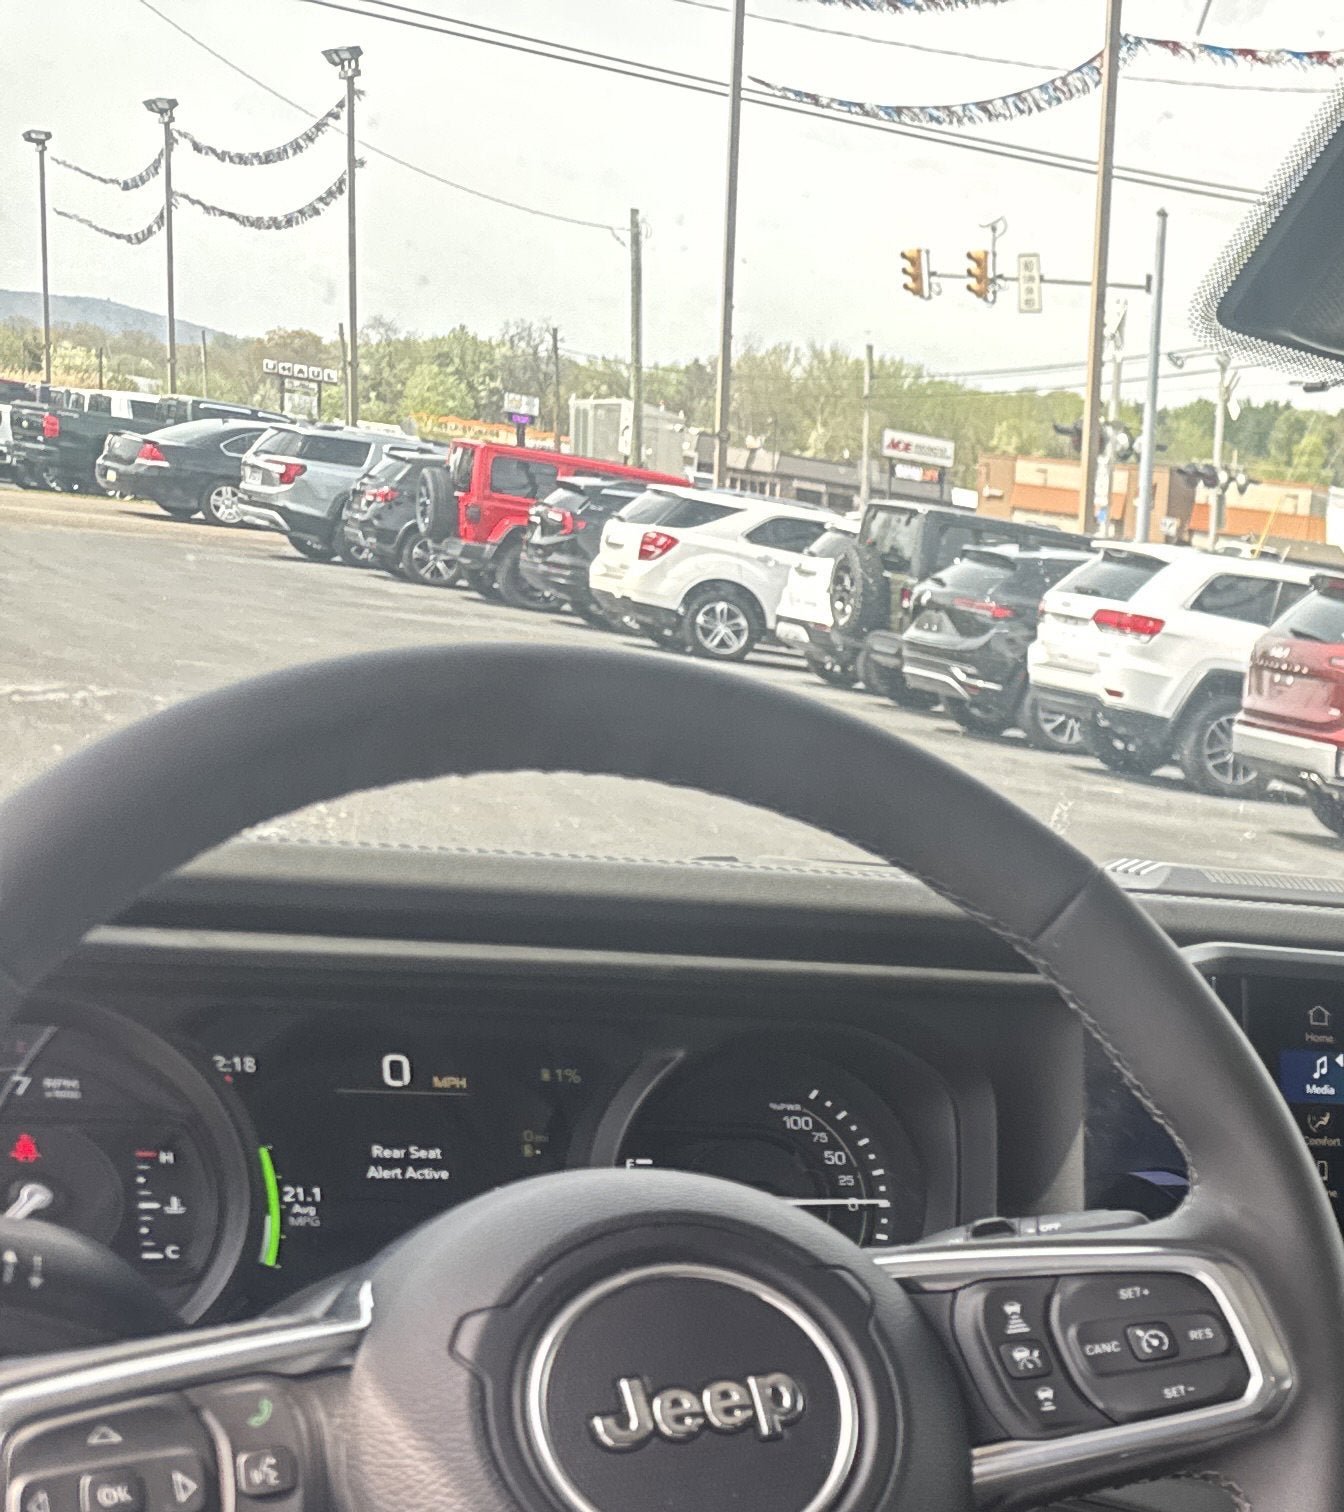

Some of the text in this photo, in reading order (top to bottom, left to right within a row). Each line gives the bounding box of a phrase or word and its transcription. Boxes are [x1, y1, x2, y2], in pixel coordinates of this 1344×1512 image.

[1305, 1033, 1335, 1043] Home
[382, 1053, 411, 1087] 0
[555, 1067, 582, 1084] 1%
[432, 1075, 467, 1089] MPH
[1305, 1083, 1336, 1095] Media
[783, 1115, 813, 1131] 100
[812, 1132, 828, 1144] 75
[159, 1151, 175, 1163] H
[371, 1145, 442, 1160] Rear Seat
[824, 1151, 846, 1165] 50
[366, 1166, 449, 1180] Alert Active
[838, 1175, 854, 1186] 25
[282, 1186, 321, 1202] 21.1
[292, 1203, 316, 1217] Avg
[289, 1215, 321, 1227] MPG
[165, 1245, 180, 1259] C
[1188, 1327, 1213, 1342] RES
[1085, 1340, 1121, 1356] CANC
[591, 1371, 804, 1448] Jeep
[98, 1484, 133, 1508] OK
